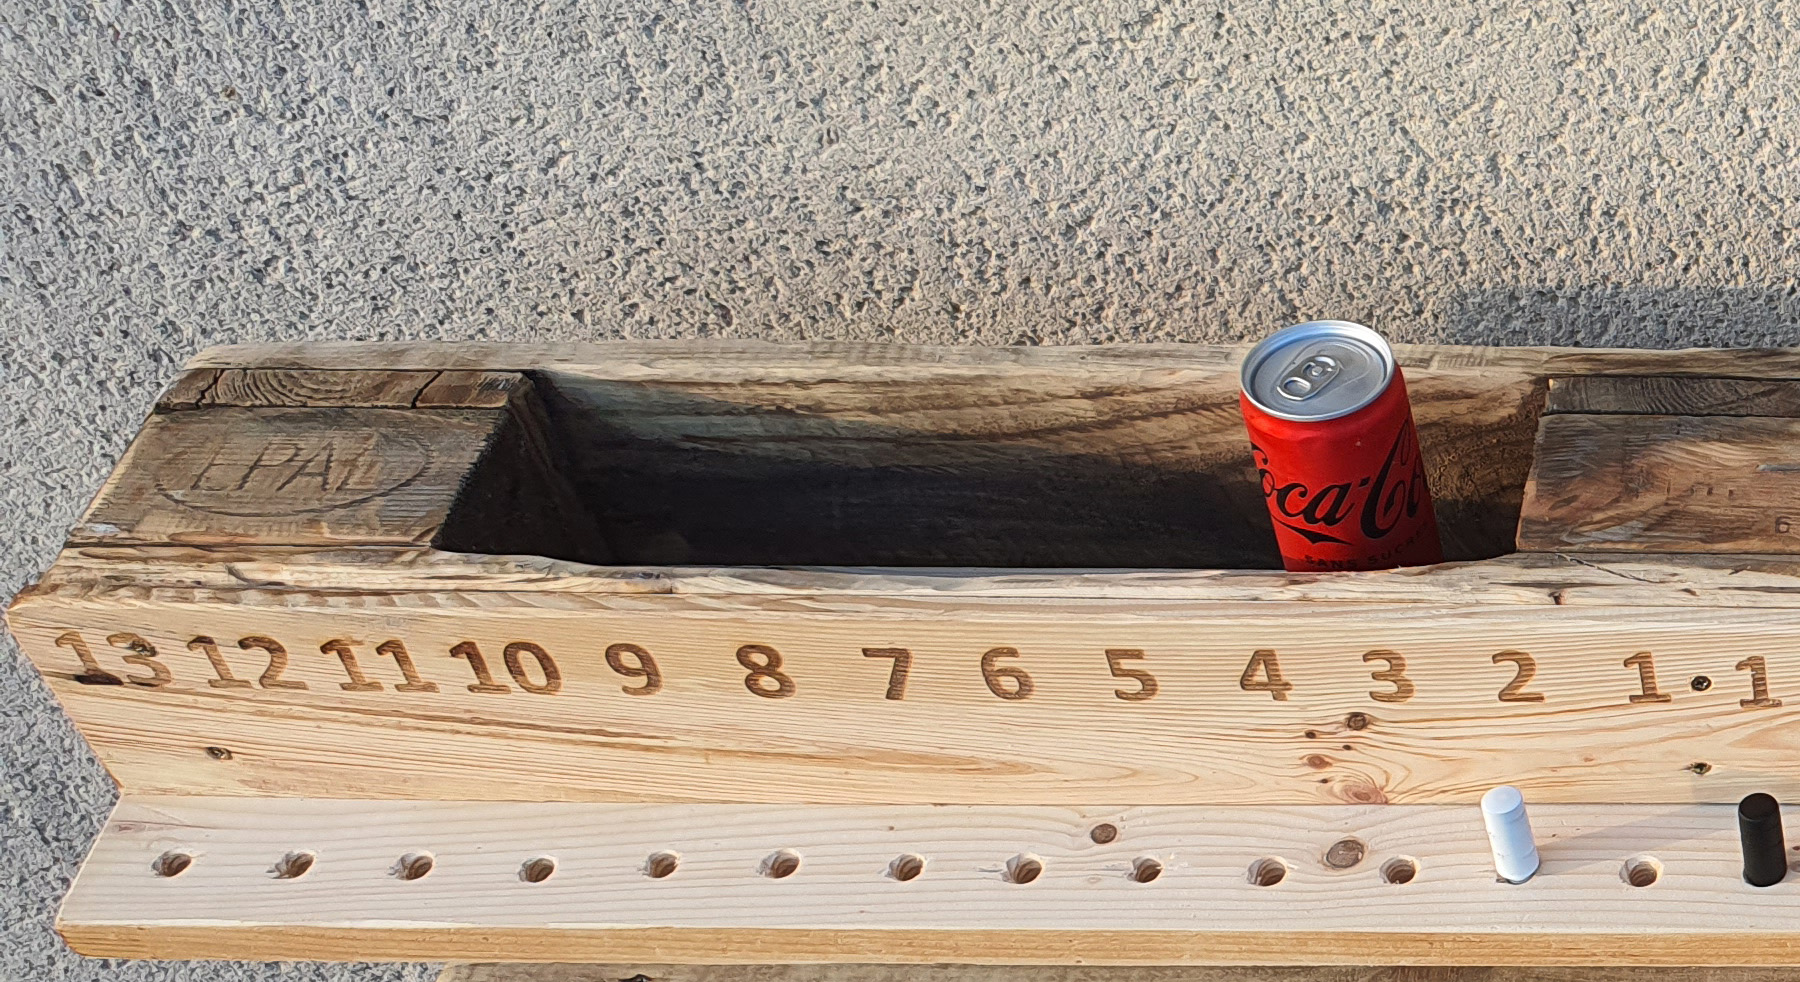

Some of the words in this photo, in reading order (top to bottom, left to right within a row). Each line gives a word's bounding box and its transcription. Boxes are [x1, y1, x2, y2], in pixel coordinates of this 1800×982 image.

[54, 631, 172, 687] 13
[187, 635, 309, 690] 12
[320, 637, 439, 693] 11
[449, 640, 562, 695] 10
[605, 643, 663, 696] 9
[736, 644, 796, 698] 8
[861, 647, 913, 701] 7
[980, 647, 1035, 701] 6
[1105, 648, 1160, 702] 5
[1240, 648, 1293, 702] 4
[1362, 649, 1415, 703] 3
[1492, 649, 1545, 703] 2
[1623, 651, 1672, 704] 1
[1735, 655, 1782, 709] 1
